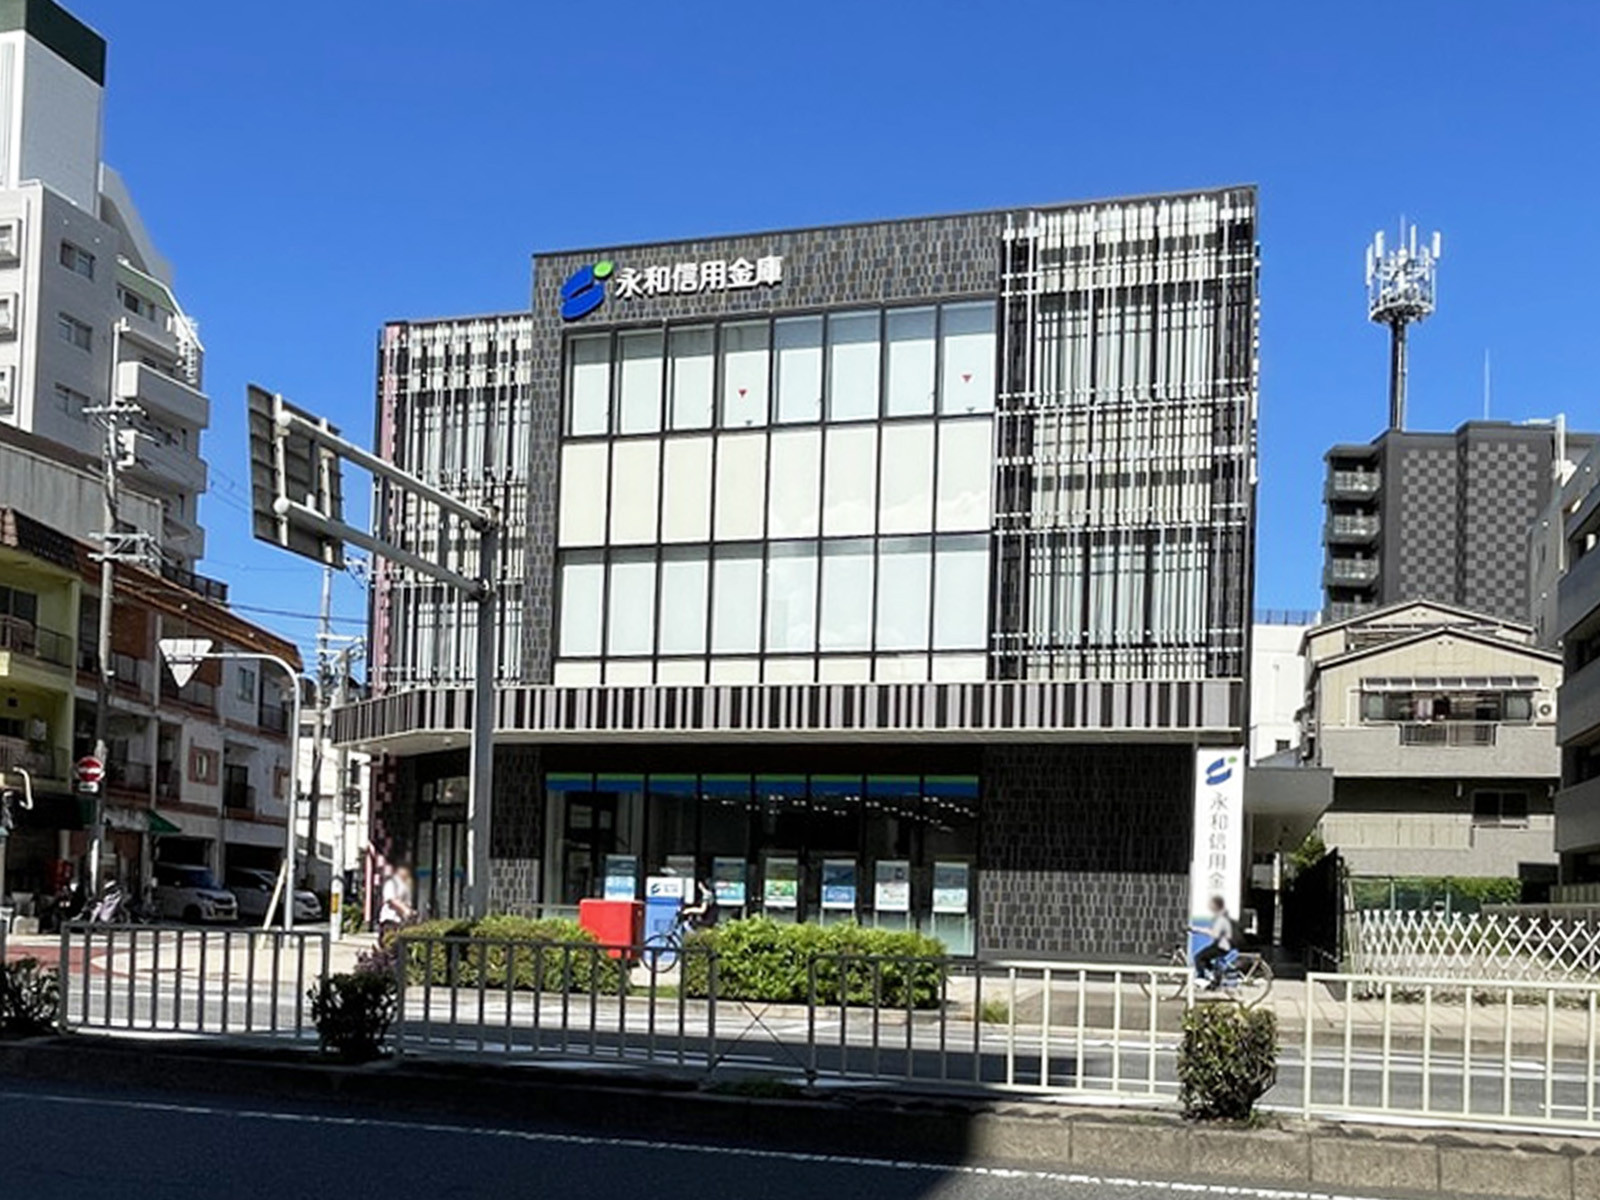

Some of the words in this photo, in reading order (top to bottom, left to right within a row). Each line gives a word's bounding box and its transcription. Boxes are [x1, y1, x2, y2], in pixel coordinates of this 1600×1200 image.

[615, 255, 783, 298] 永和信用金庫
[1208, 792, 1229, 898] 永和信用金
